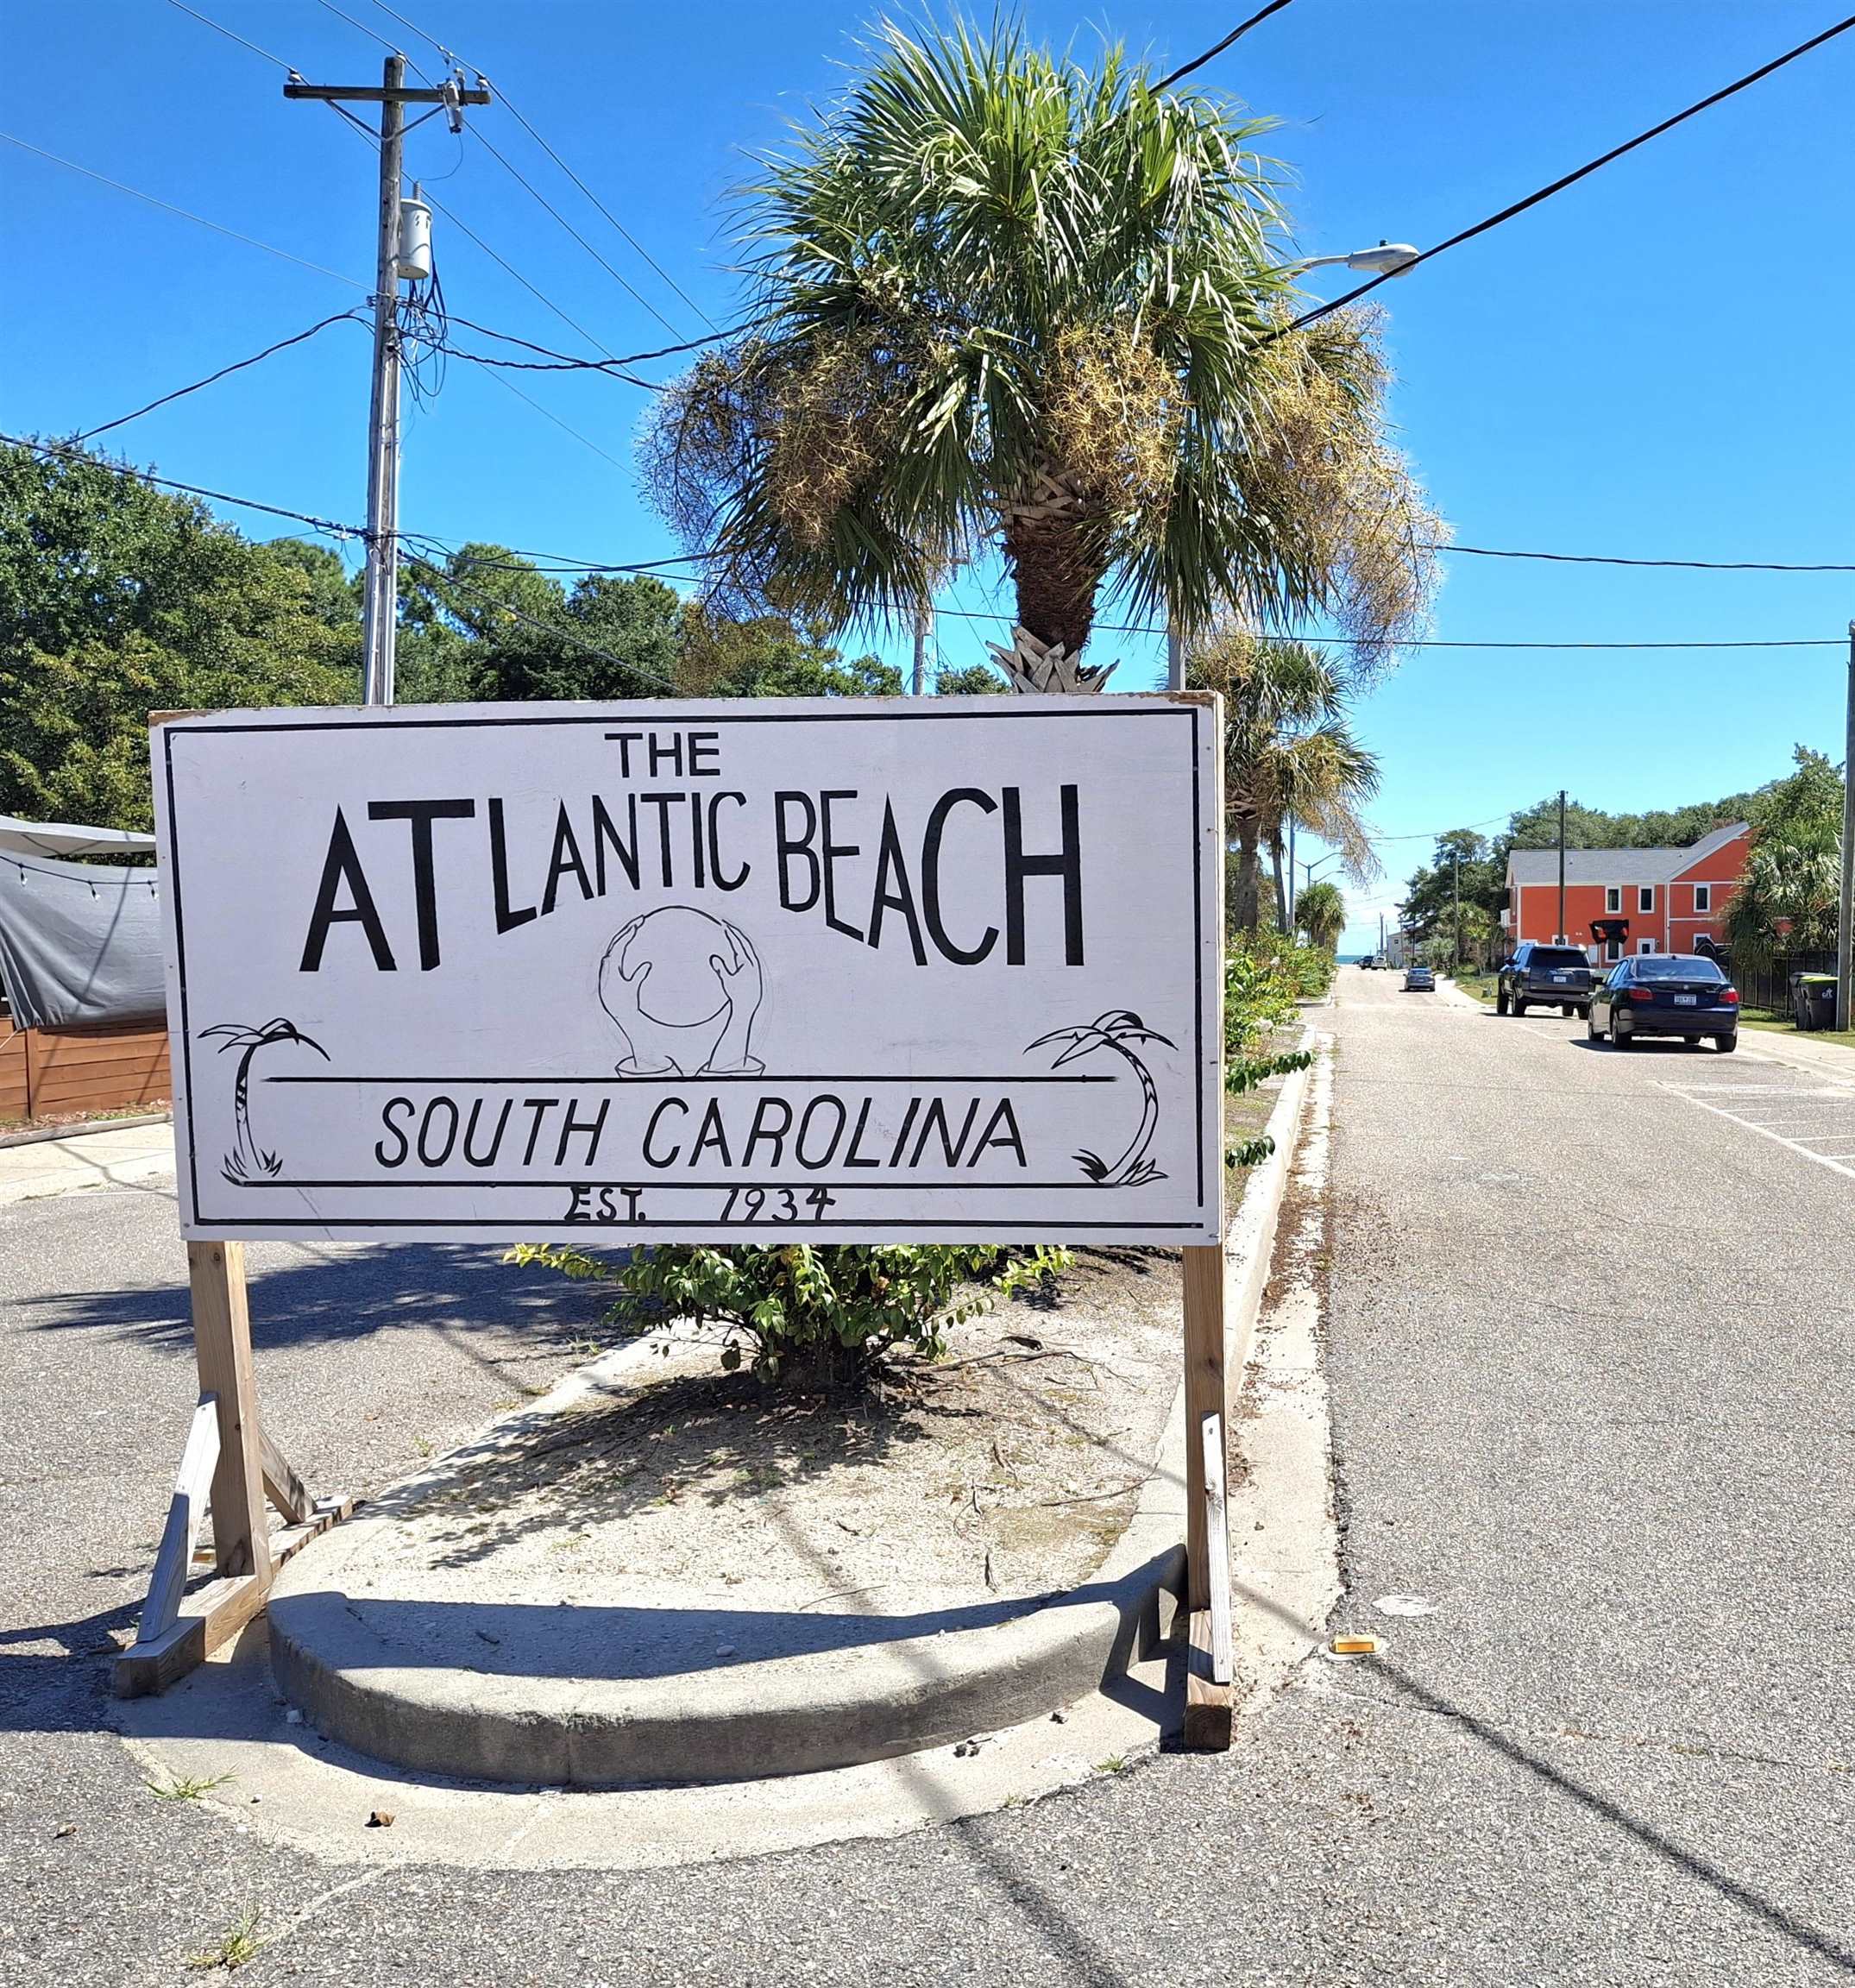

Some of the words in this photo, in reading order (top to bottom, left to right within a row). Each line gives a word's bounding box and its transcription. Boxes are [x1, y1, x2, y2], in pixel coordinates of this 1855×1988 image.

[605, 732, 721, 777] THE
[299, 791, 751, 972] ATLANTIC
[775, 783, 1085, 966] BEACH
[374, 1096, 611, 1170] SOUTH
[641, 1096, 1028, 1169] CAROLINA
[563, 1186, 647, 1222] EST.
[720, 1187, 837, 1222] 1934
